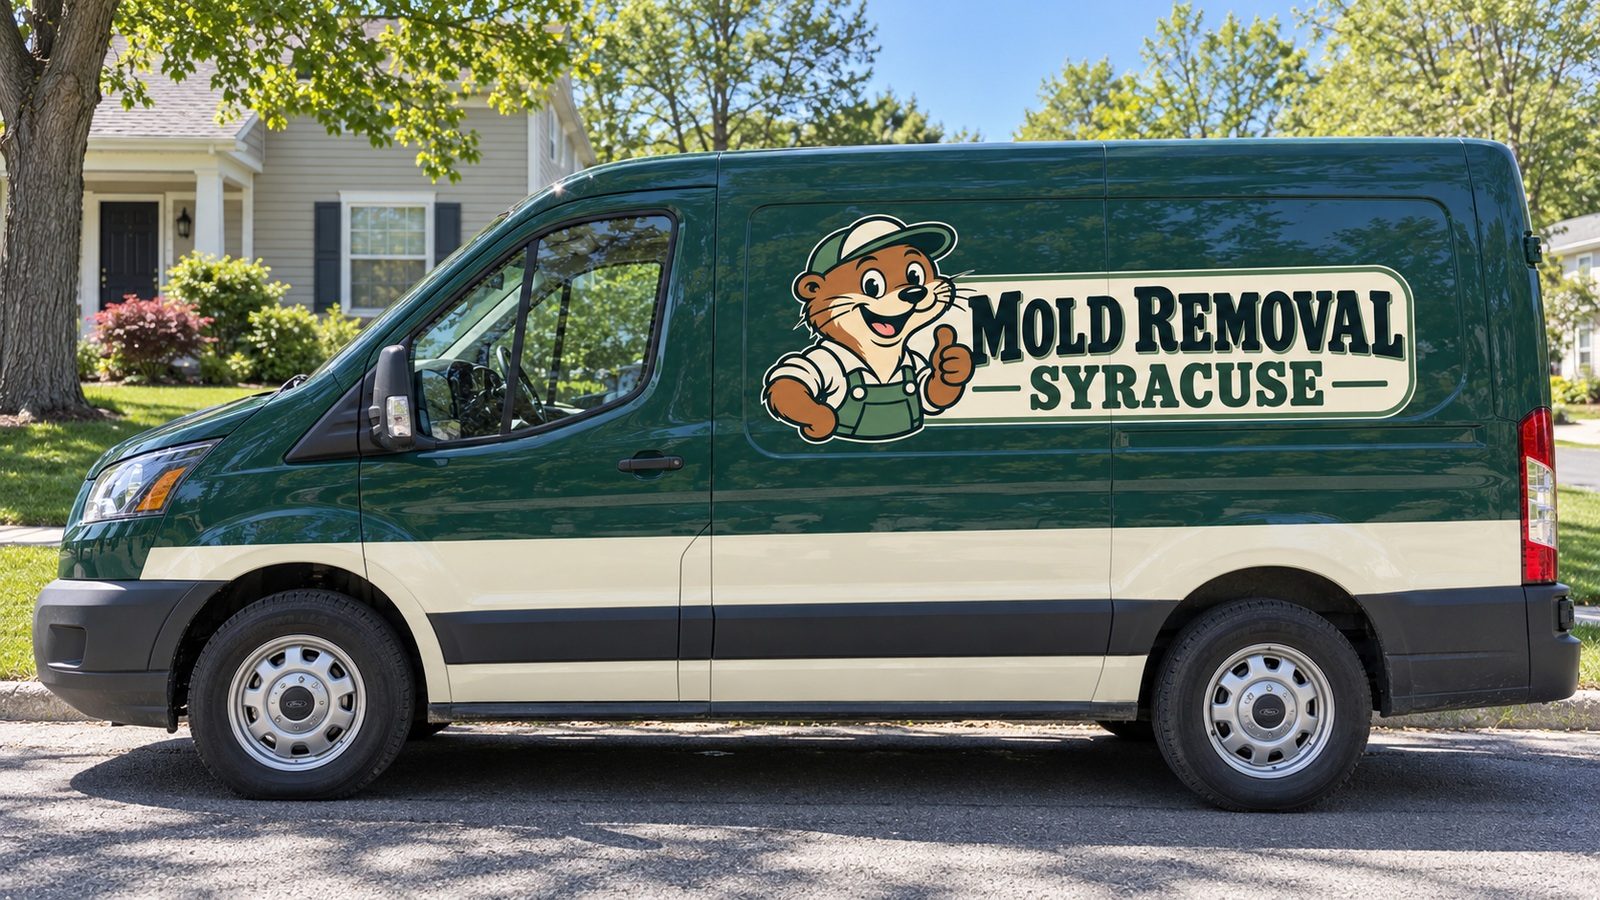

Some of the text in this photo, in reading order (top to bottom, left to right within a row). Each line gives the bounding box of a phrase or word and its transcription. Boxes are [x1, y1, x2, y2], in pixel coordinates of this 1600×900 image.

[968, 286, 1406, 367] MOLD REMOVAL
[1030, 361, 1324, 410] SYRACUSE
